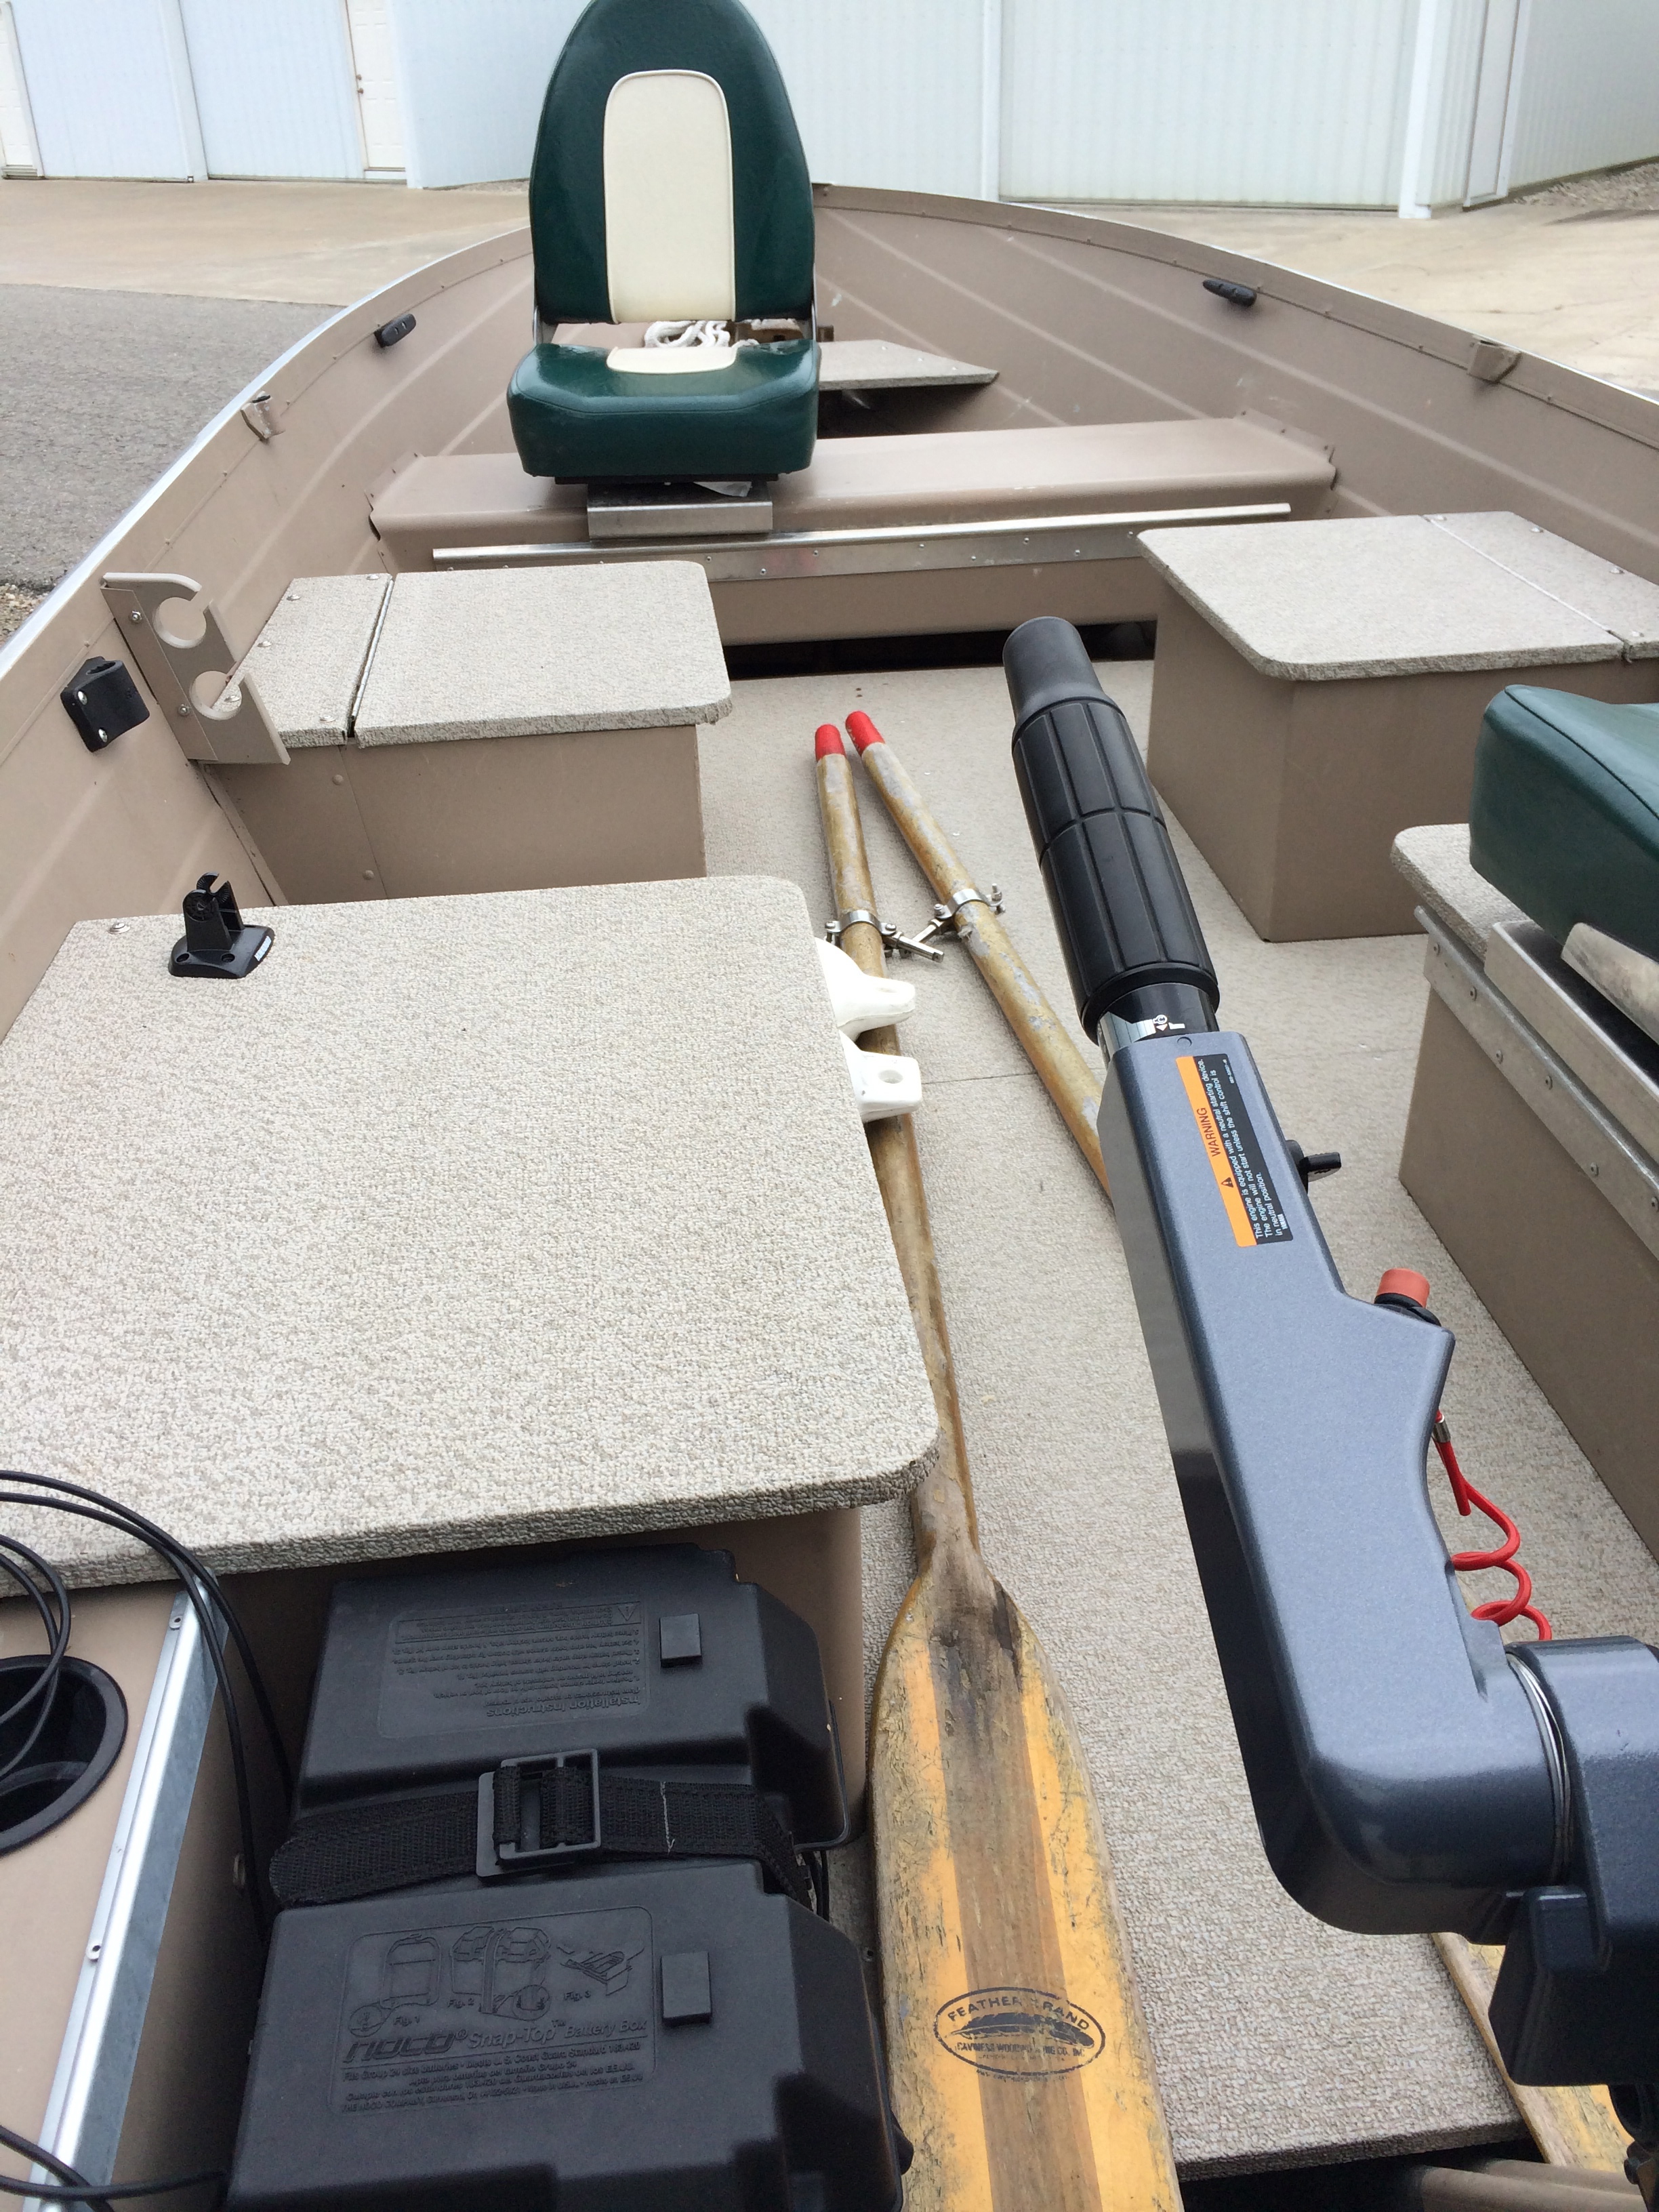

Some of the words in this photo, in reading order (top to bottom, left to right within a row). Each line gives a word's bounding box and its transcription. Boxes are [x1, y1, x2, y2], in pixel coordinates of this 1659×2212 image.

[1198, 1059, 1209, 1082] device.
[1206, 1083, 1218, 1107] starting
[1212, 1078, 1225, 1099] control
[1220, 1101, 1231, 1115] shift
[1213, 1109, 1227, 1132] neutral
[1227, 1118, 1235, 1129] the
[1197, 1107, 1221, 1157] WARNING
[1231, 1130, 1243, 1151] unless
[1224, 1139, 1234, 1154] with
[1229, 1155, 1246, 1187] equipped
[1238, 1153, 1249, 1169] start
[1245, 1170, 1254, 1181] not
[1248, 1183, 1258, 1195] will
[1256, 1172, 1271, 1201] position.
[1245, 1197, 1257, 1221] engine
[1255, 1197, 1267, 1221] engine
[1265, 1203, 1279, 1227] neutral
[1254, 1223, 1263, 1239] This
[1264, 1223, 1273, 1237] The
[486, 1700, 567, 1718] Instructions
[570, 1695, 641, 1711] Installation
[947, 1996, 1022, 2022] FEATHER
[565, 2024, 616, 2039] Battery
[619, 2020, 647, 2033] Box
